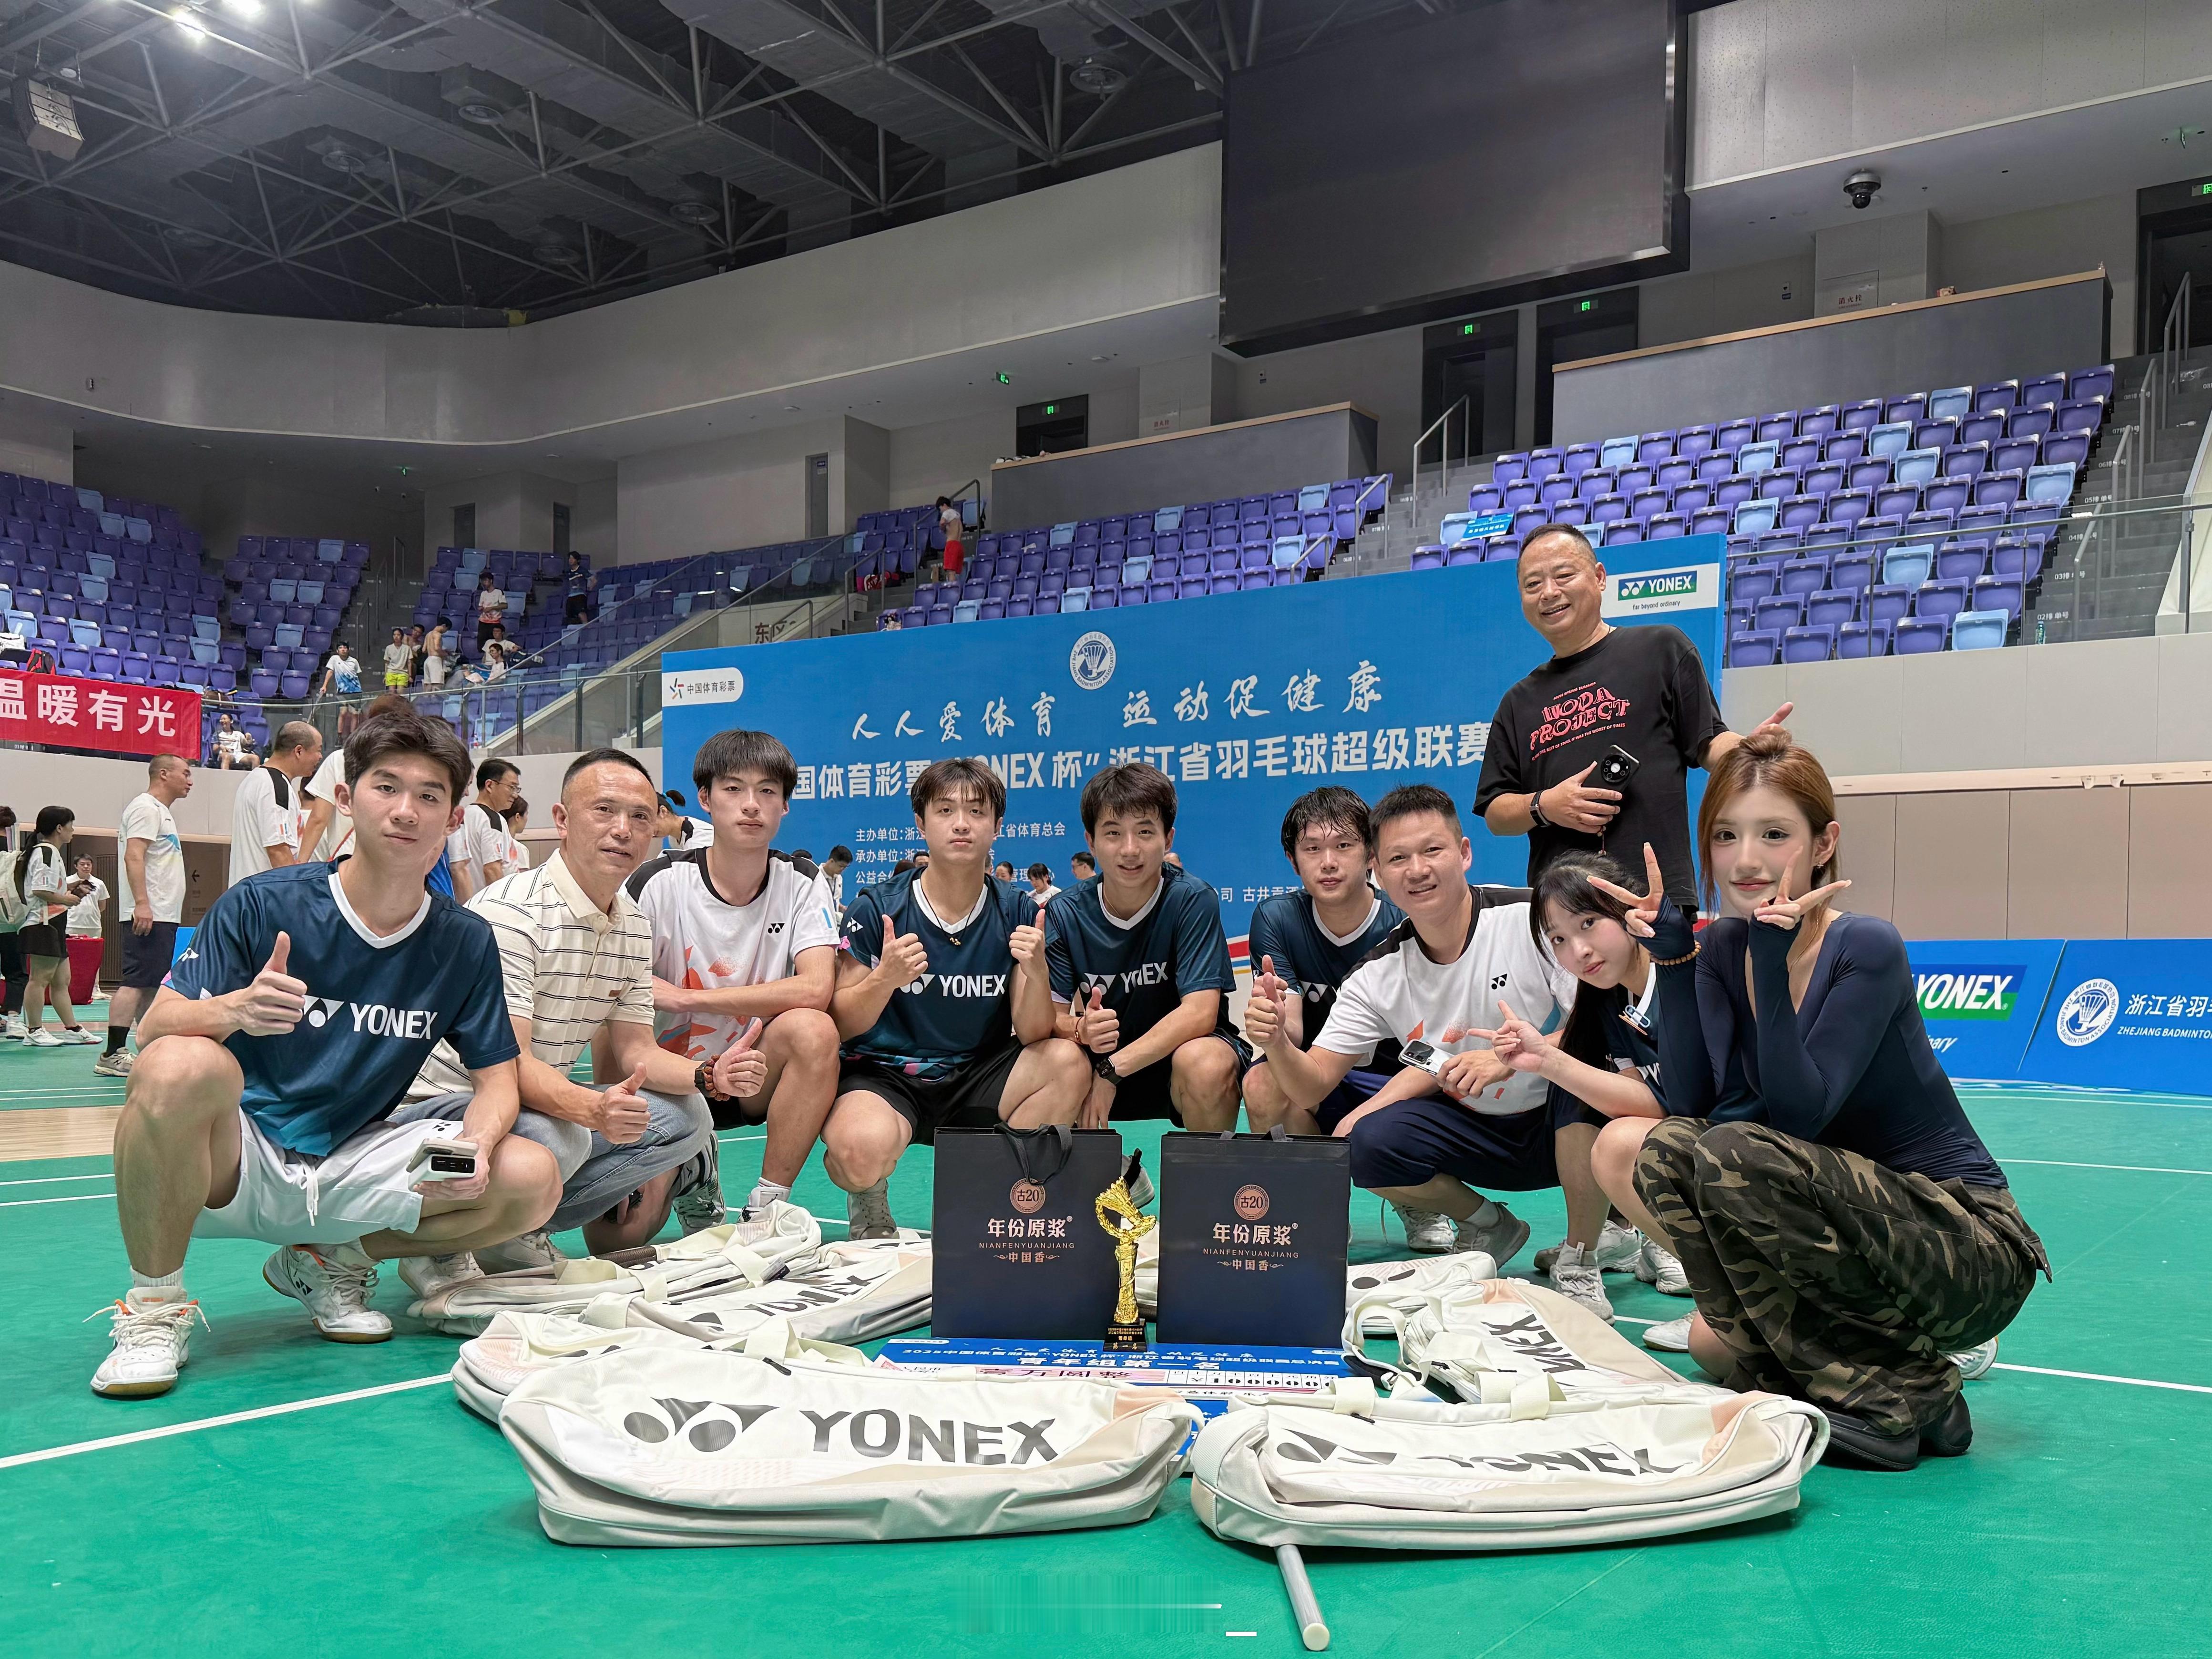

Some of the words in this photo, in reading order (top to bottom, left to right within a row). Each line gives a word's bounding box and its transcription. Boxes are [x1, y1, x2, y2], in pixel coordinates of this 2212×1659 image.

[1648, 574, 1692, 594] YONEX
[1641, 602, 1659, 611] beyond
[1660, 600, 1681, 608] ordinary
[687, 680, 735, 695] 中国体育彩票
[852, 692, 1055, 742] 人人爱体育
[1122, 660, 1382, 728] 运动促健康
[1529, 699, 1630, 750] PROJECT
[939, 974, 1006, 998] YONEX
[1120, 961, 1168, 994] YONEX
[1916, 973, 2014, 1010] YONEX
[349, 1002, 438, 1040] YONEX
[2060, 1029, 2090, 1044] BADMINTON
[2090, 998, 2117, 1038] ASSOCIATION
[2117, 1026, 2161, 1037] ZHEJIANG
[1017, 1189, 1039, 1202] 古20
[1240, 1196, 1263, 1208] 古20
[987, 1218, 1066, 1238] 年份原浆
[1212, 1222, 1291, 1246] 年份原浆
[1008, 1251, 1045, 1263] 中国香
[1203, 1248, 1299, 1259] NIANFENYUANJIANG
[1232, 1259, 1269, 1271] 中国香
[1017, 1357, 1220, 1370] 青年组第一名
[799, 1408, 1059, 1466] YONEX
[1416, 1442, 1694, 1477] YONEX
